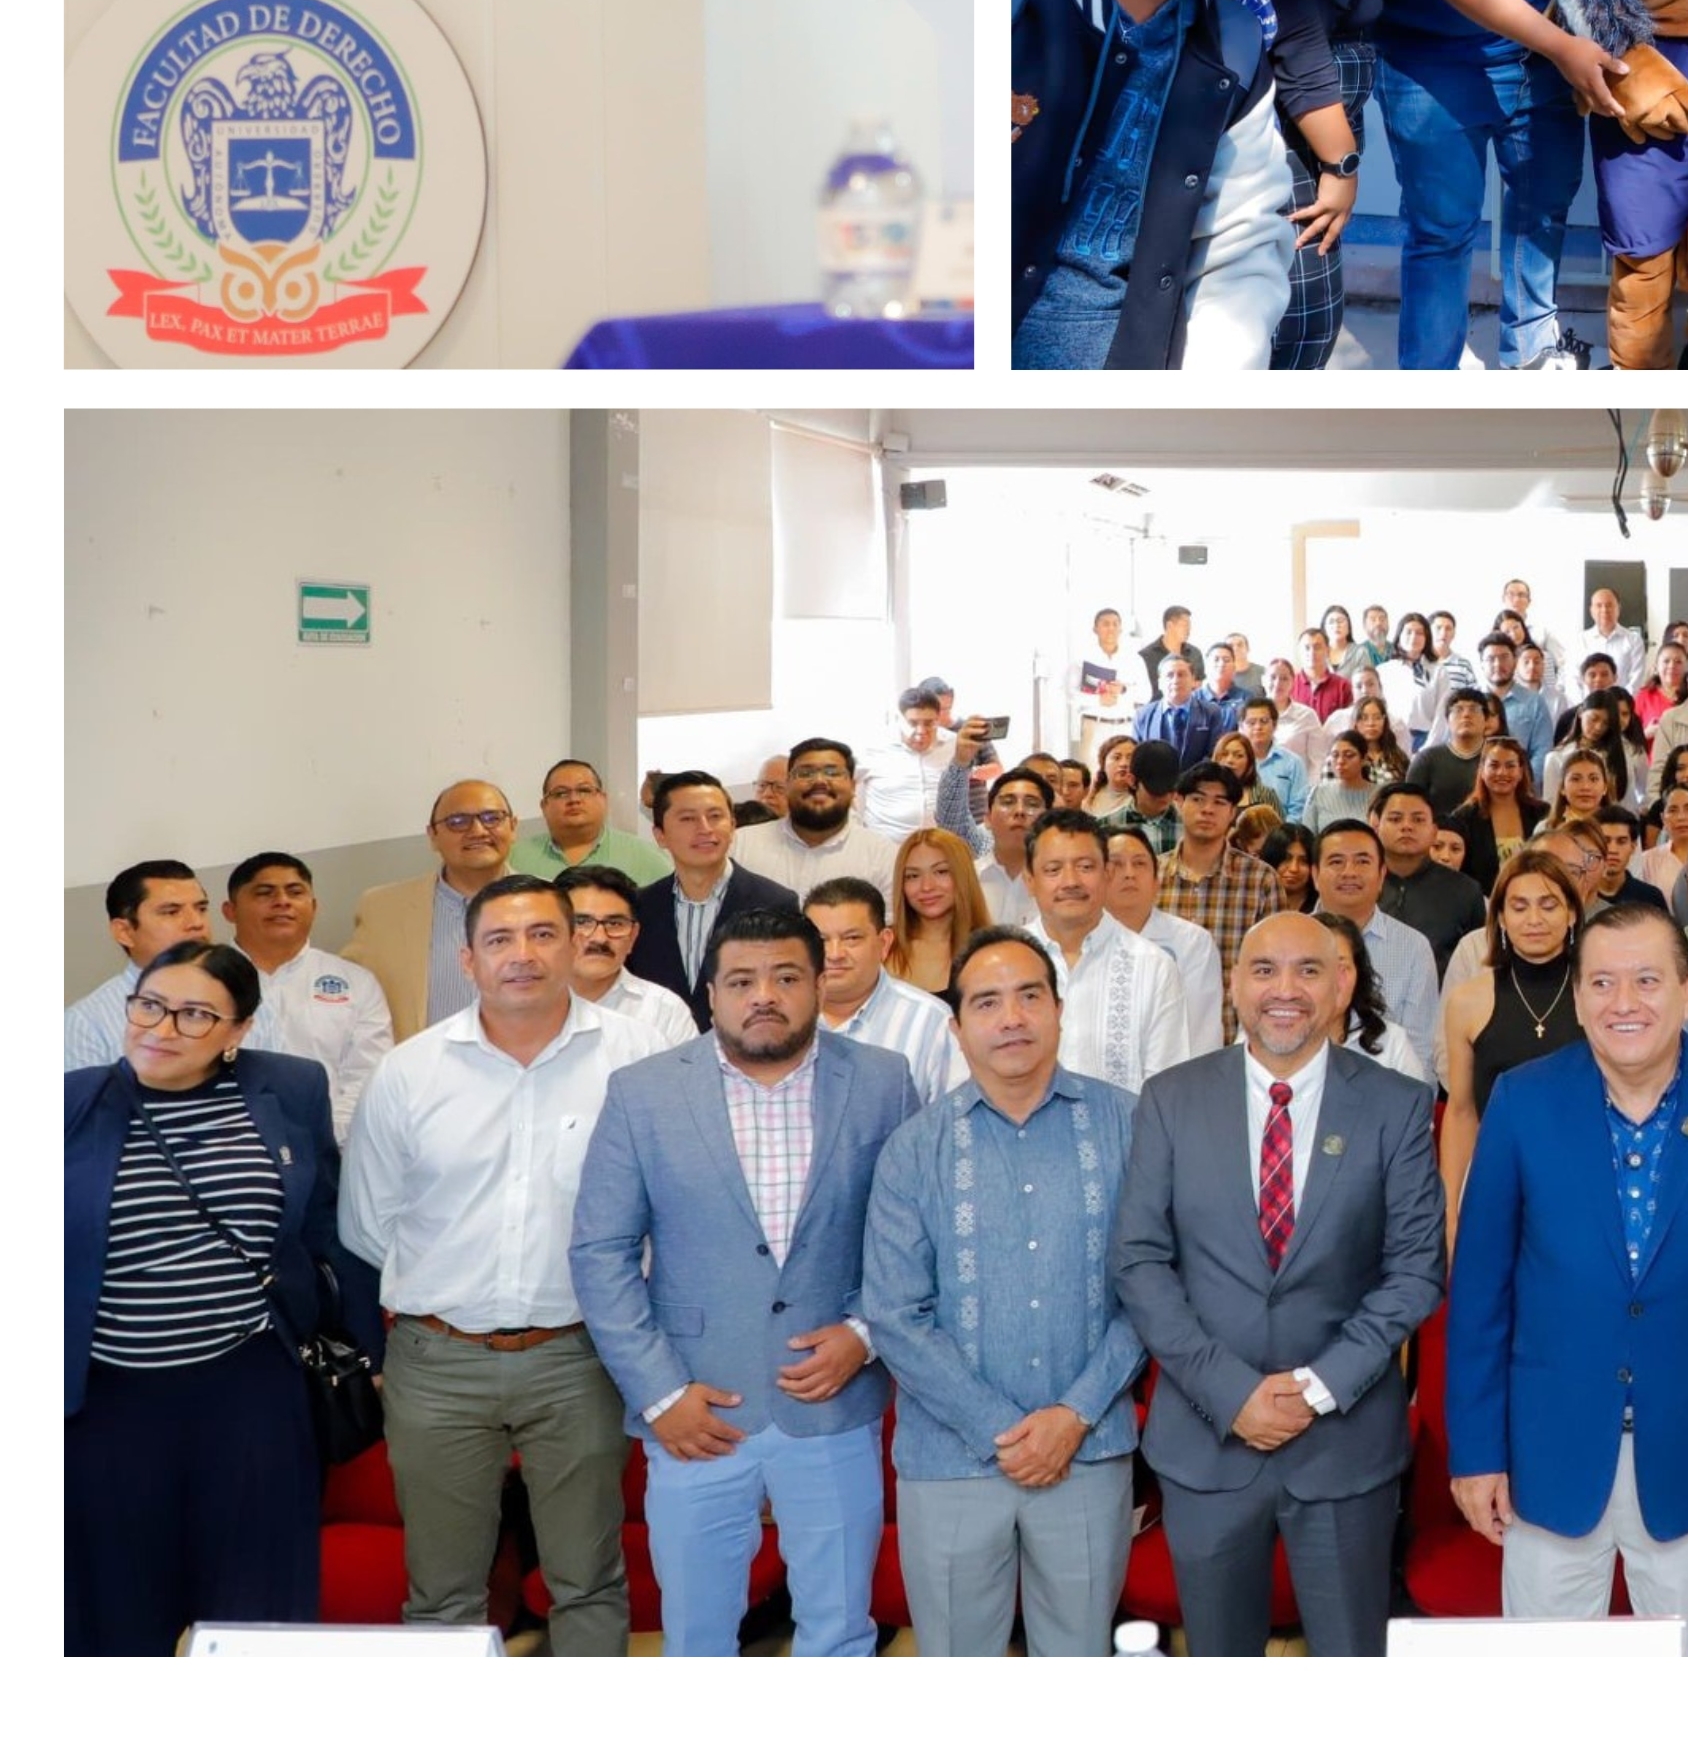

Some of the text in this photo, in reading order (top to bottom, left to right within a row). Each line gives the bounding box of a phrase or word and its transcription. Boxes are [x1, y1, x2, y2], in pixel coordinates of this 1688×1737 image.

[132, 5, 402, 148] FACULTAD DE DERECHO
[216, 126, 320, 136] UNIVERSIDAD
[190, 318, 222, 341] PAX
[226, 327, 249, 344] ET
[253, 326, 313, 346] MATER
[316, 310, 385, 343] TERRAE
